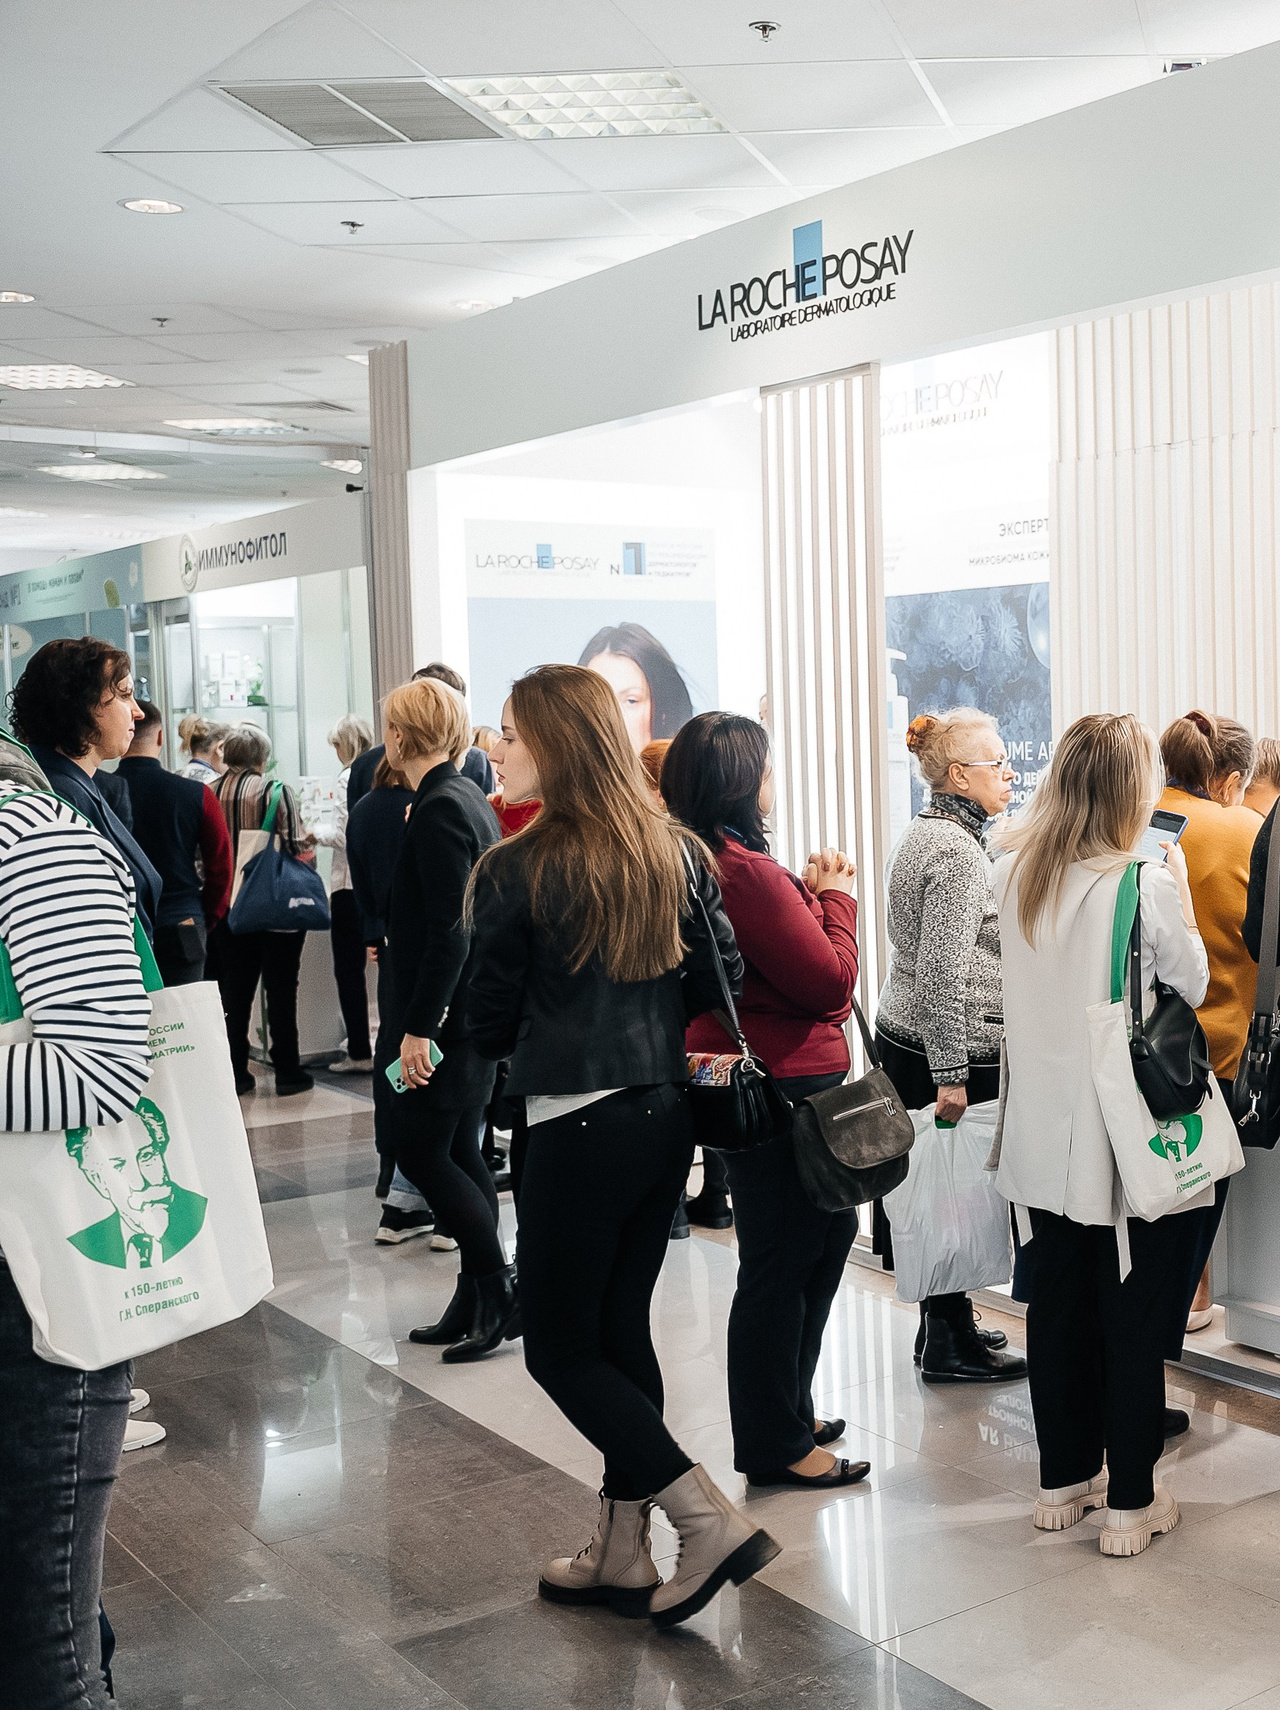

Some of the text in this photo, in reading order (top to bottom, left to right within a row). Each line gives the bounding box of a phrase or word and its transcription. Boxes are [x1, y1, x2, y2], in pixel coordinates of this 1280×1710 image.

[698, 229, 914, 331] LA ROCHE POSAY
[731, 310, 797, 342] LABORATOIRE
[998, 518, 1049, 537] ЭКСПЕРТ
[199, 532, 287, 571] ИММУНОФИТОЛ
[475, 554, 600, 570] LA ROCHE POSAY
[149, 1022, 185, 1036] ОССИИ
[151, 1044, 195, 1060] ИАТРИИ»
[131, 1276, 184, 1297] 150-летию
[135, 1291, 200, 1317] Сперанского
